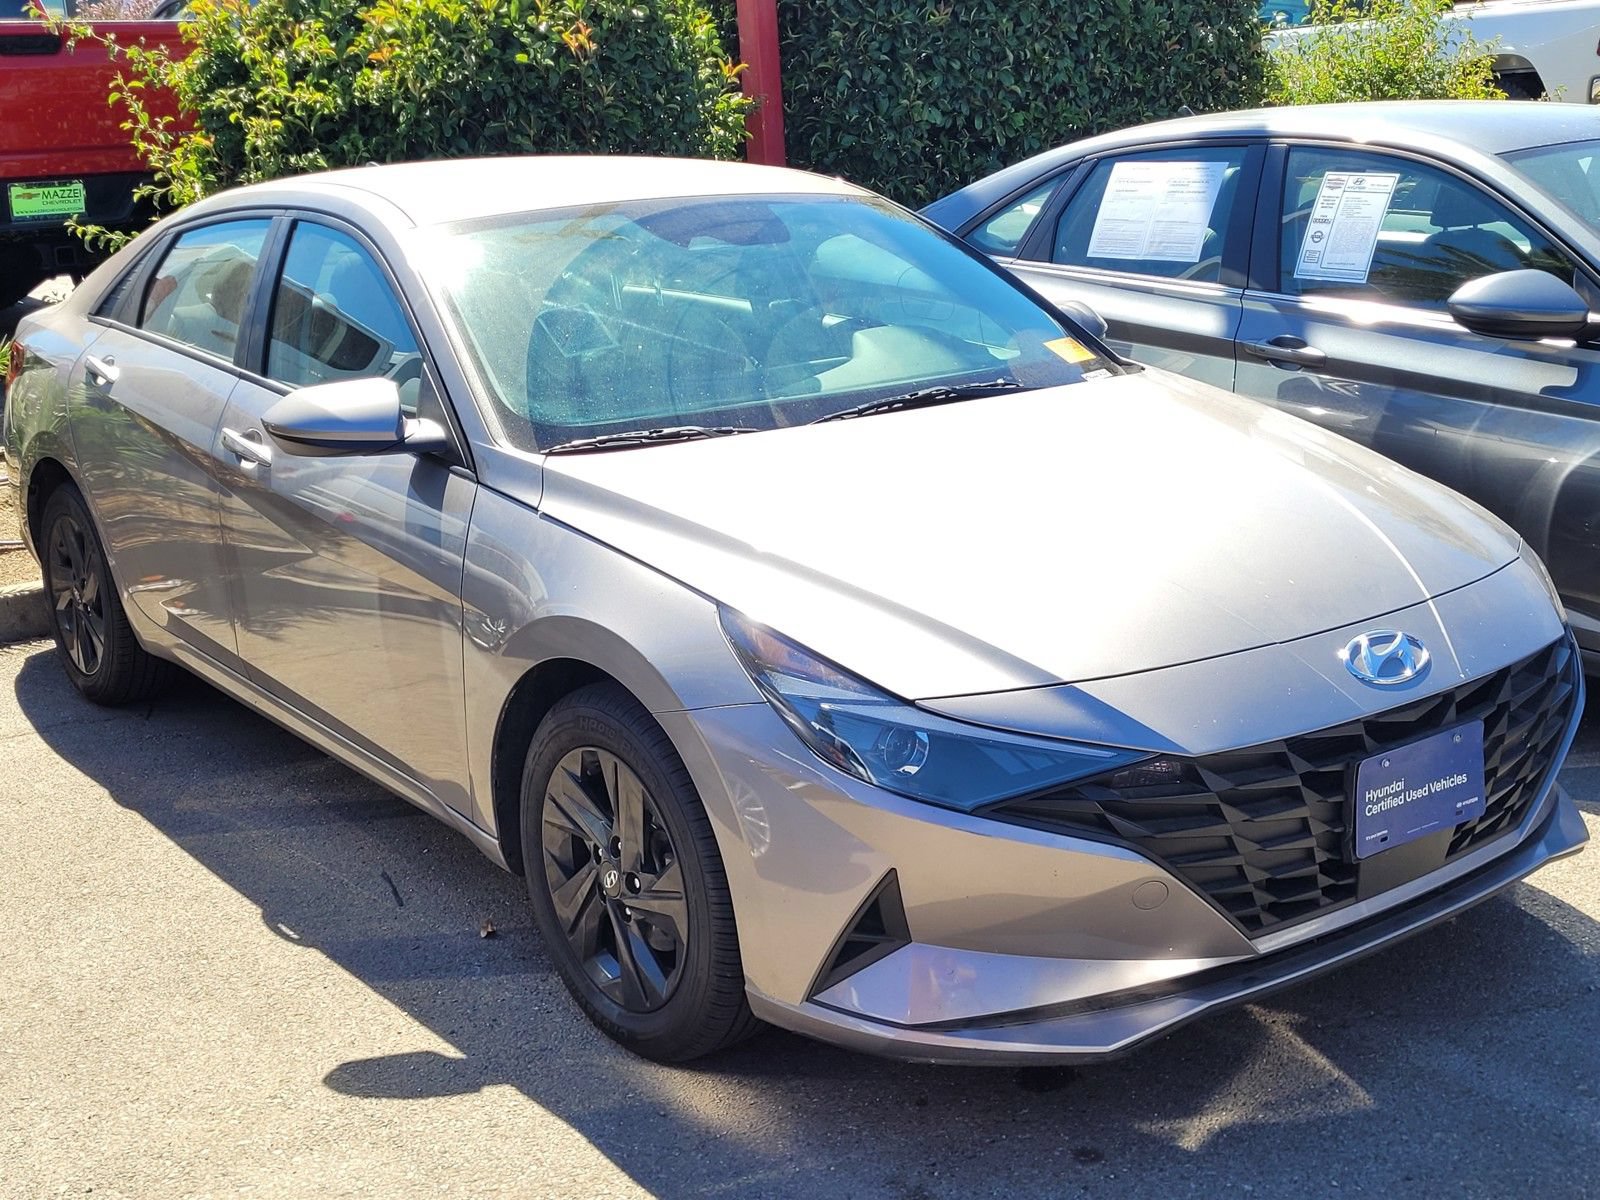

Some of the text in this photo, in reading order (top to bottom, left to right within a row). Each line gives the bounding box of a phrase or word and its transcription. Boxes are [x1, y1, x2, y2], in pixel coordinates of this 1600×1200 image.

[42, 188, 82, 200] MAZZEI
[1365, 778, 1405, 803] Hyundai
[1365, 773, 1468, 817] Certified Used Vehicles
